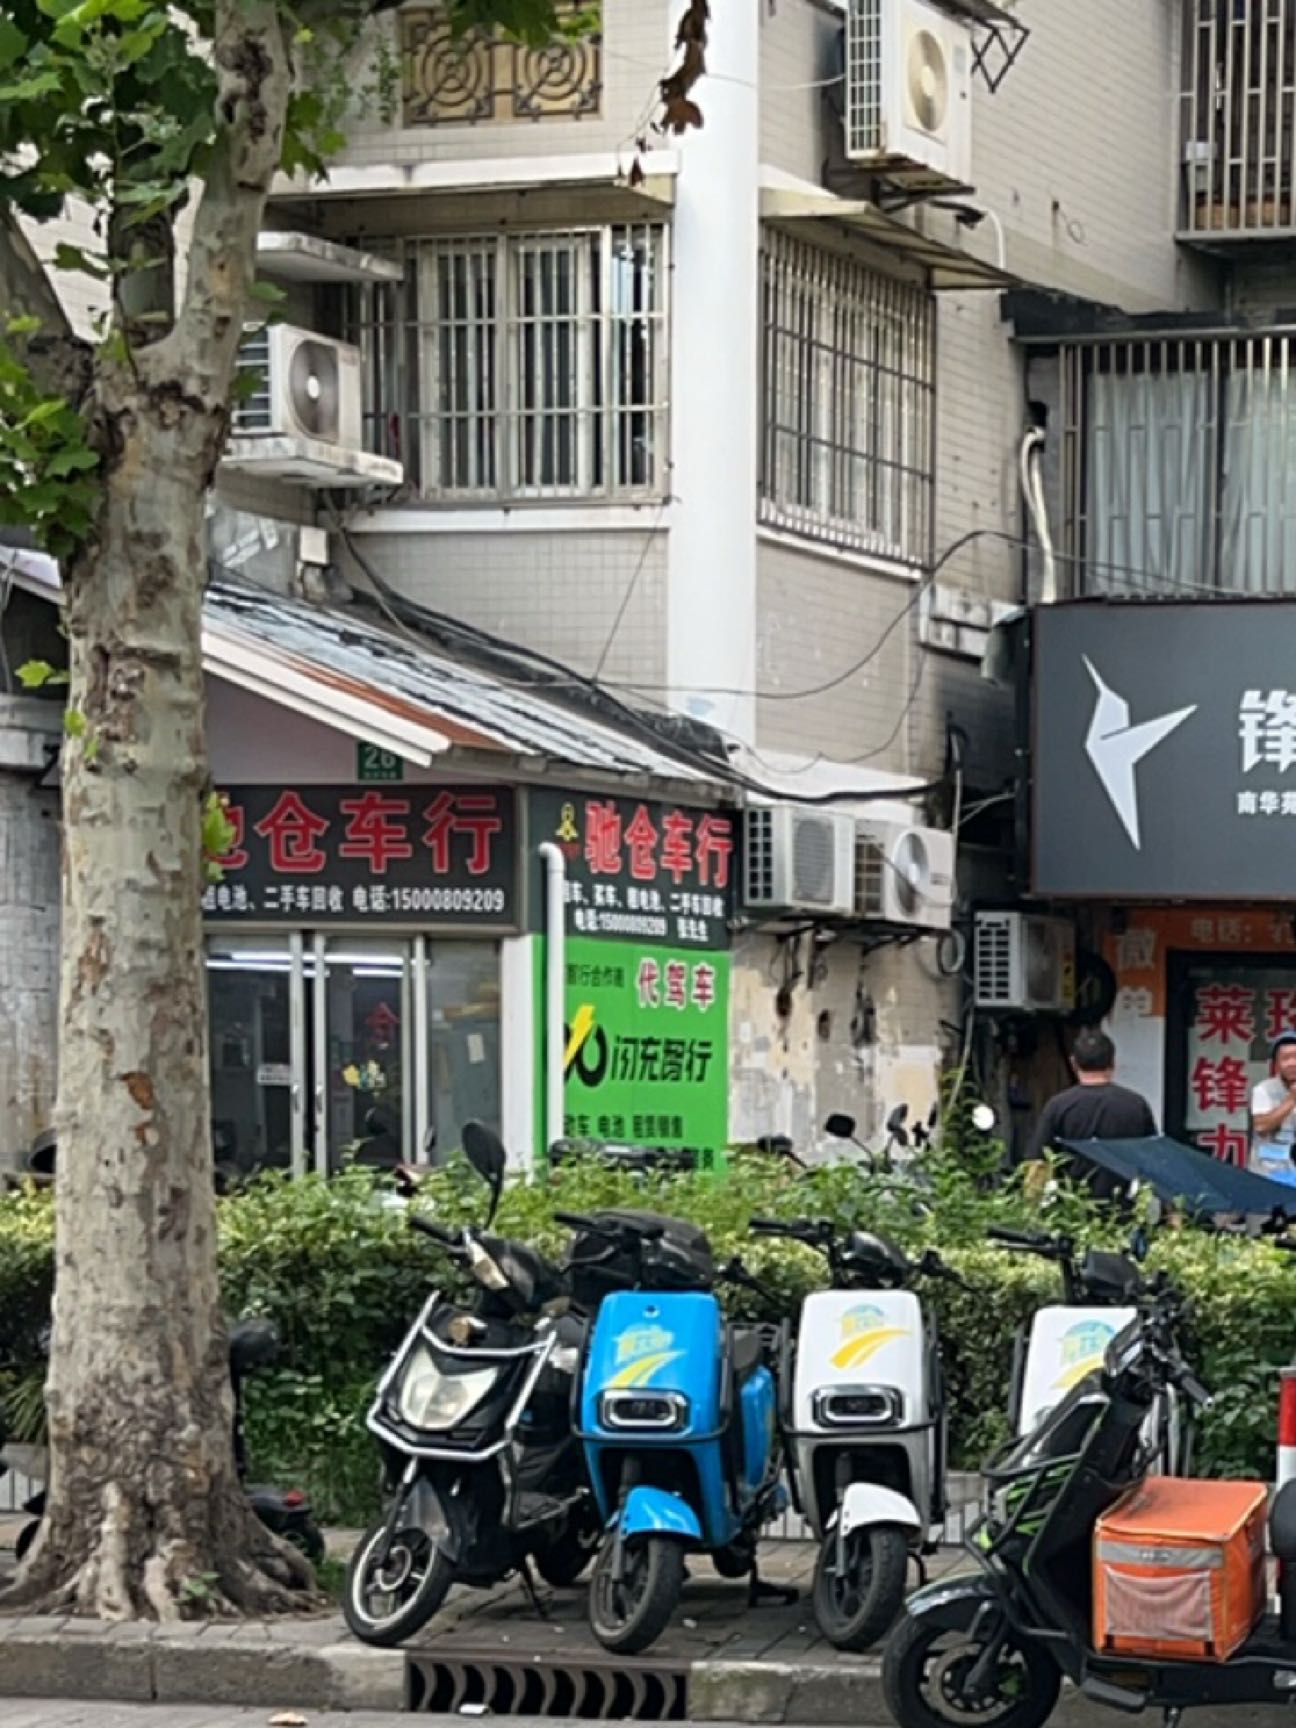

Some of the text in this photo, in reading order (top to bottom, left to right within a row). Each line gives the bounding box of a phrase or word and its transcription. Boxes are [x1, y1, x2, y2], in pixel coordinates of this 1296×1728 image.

[202, 791, 500, 874] 仓车行
[585, 800, 732, 888] 驰仓车行
[635, 957, 716, 1013] 代驾车
